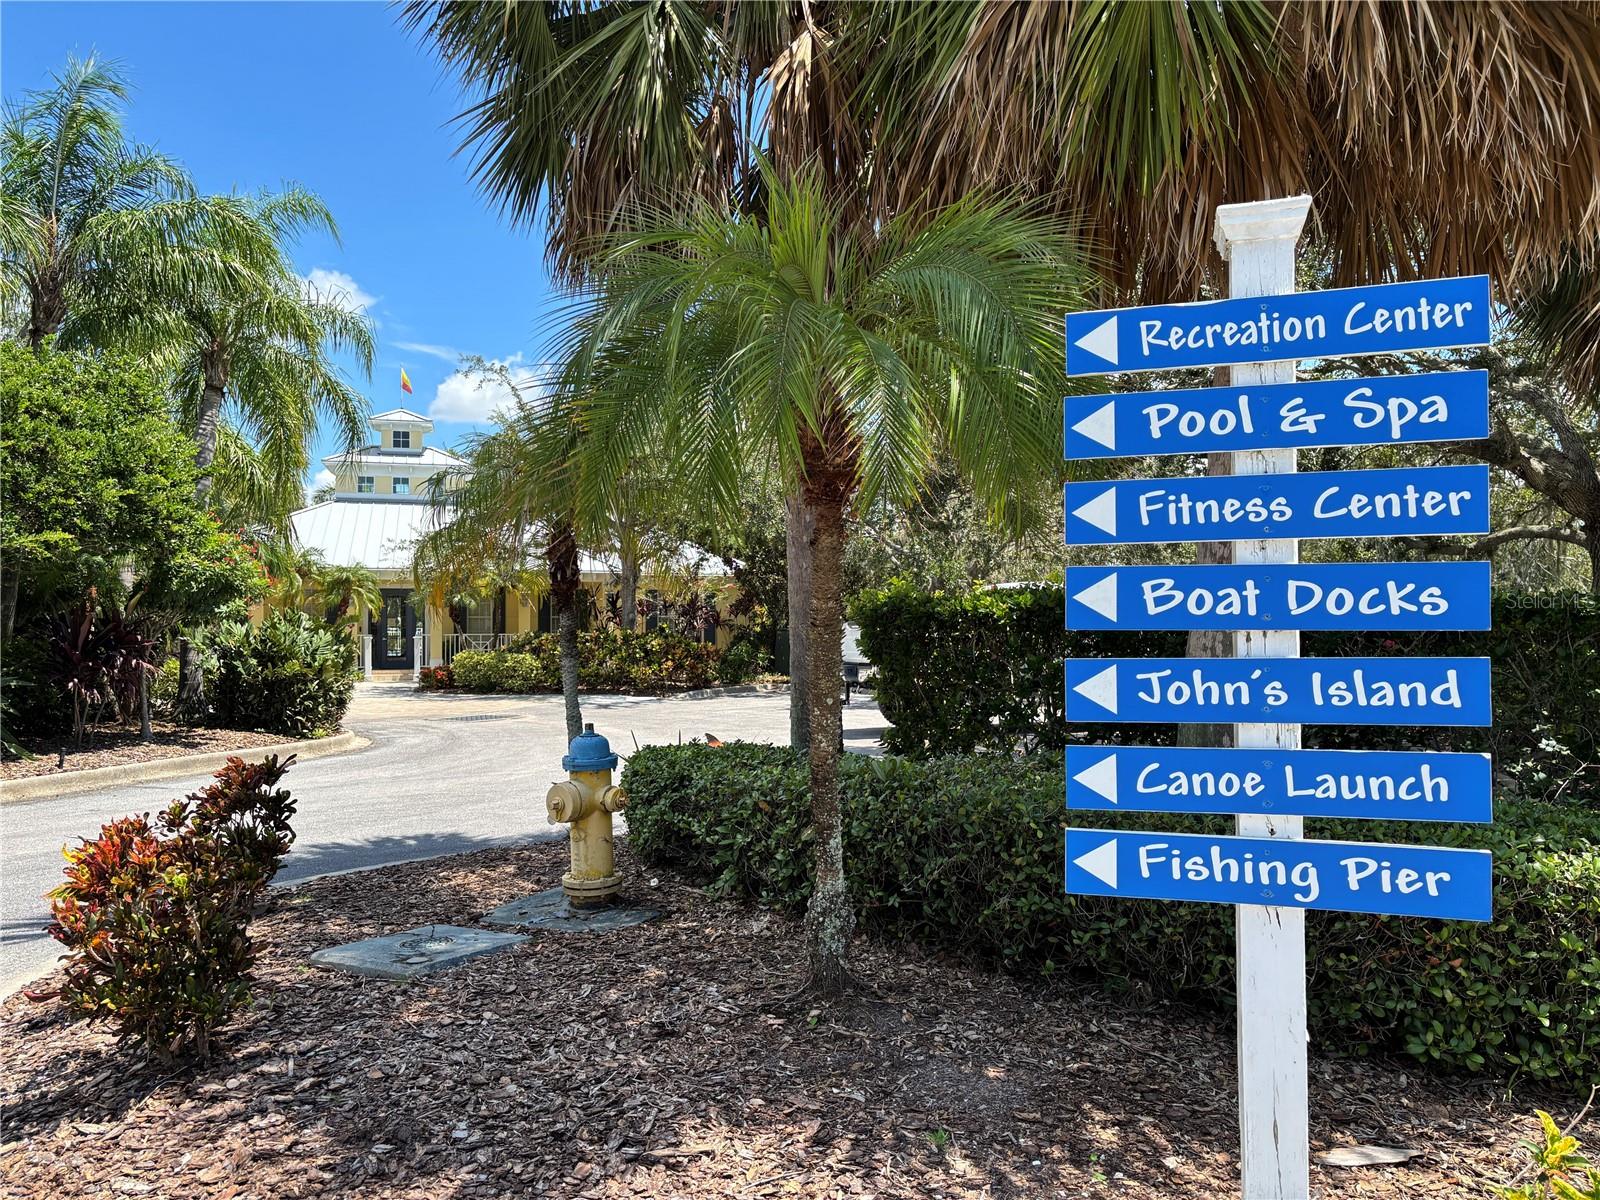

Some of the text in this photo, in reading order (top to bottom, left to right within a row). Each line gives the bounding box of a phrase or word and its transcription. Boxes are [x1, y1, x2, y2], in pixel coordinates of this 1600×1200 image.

[1139, 297, 1473, 357] Recreation Center
[1142, 387, 1448, 440] Pool & Spa
[1139, 484, 1472, 526] Fitness Center
[1141, 578, 1449, 617] Boat Docks
[1311, 669, 1462, 709] Island
[1136, 762, 1449, 802] Canoe Launch
[1138, 843, 1451, 903] Fishing Pier
